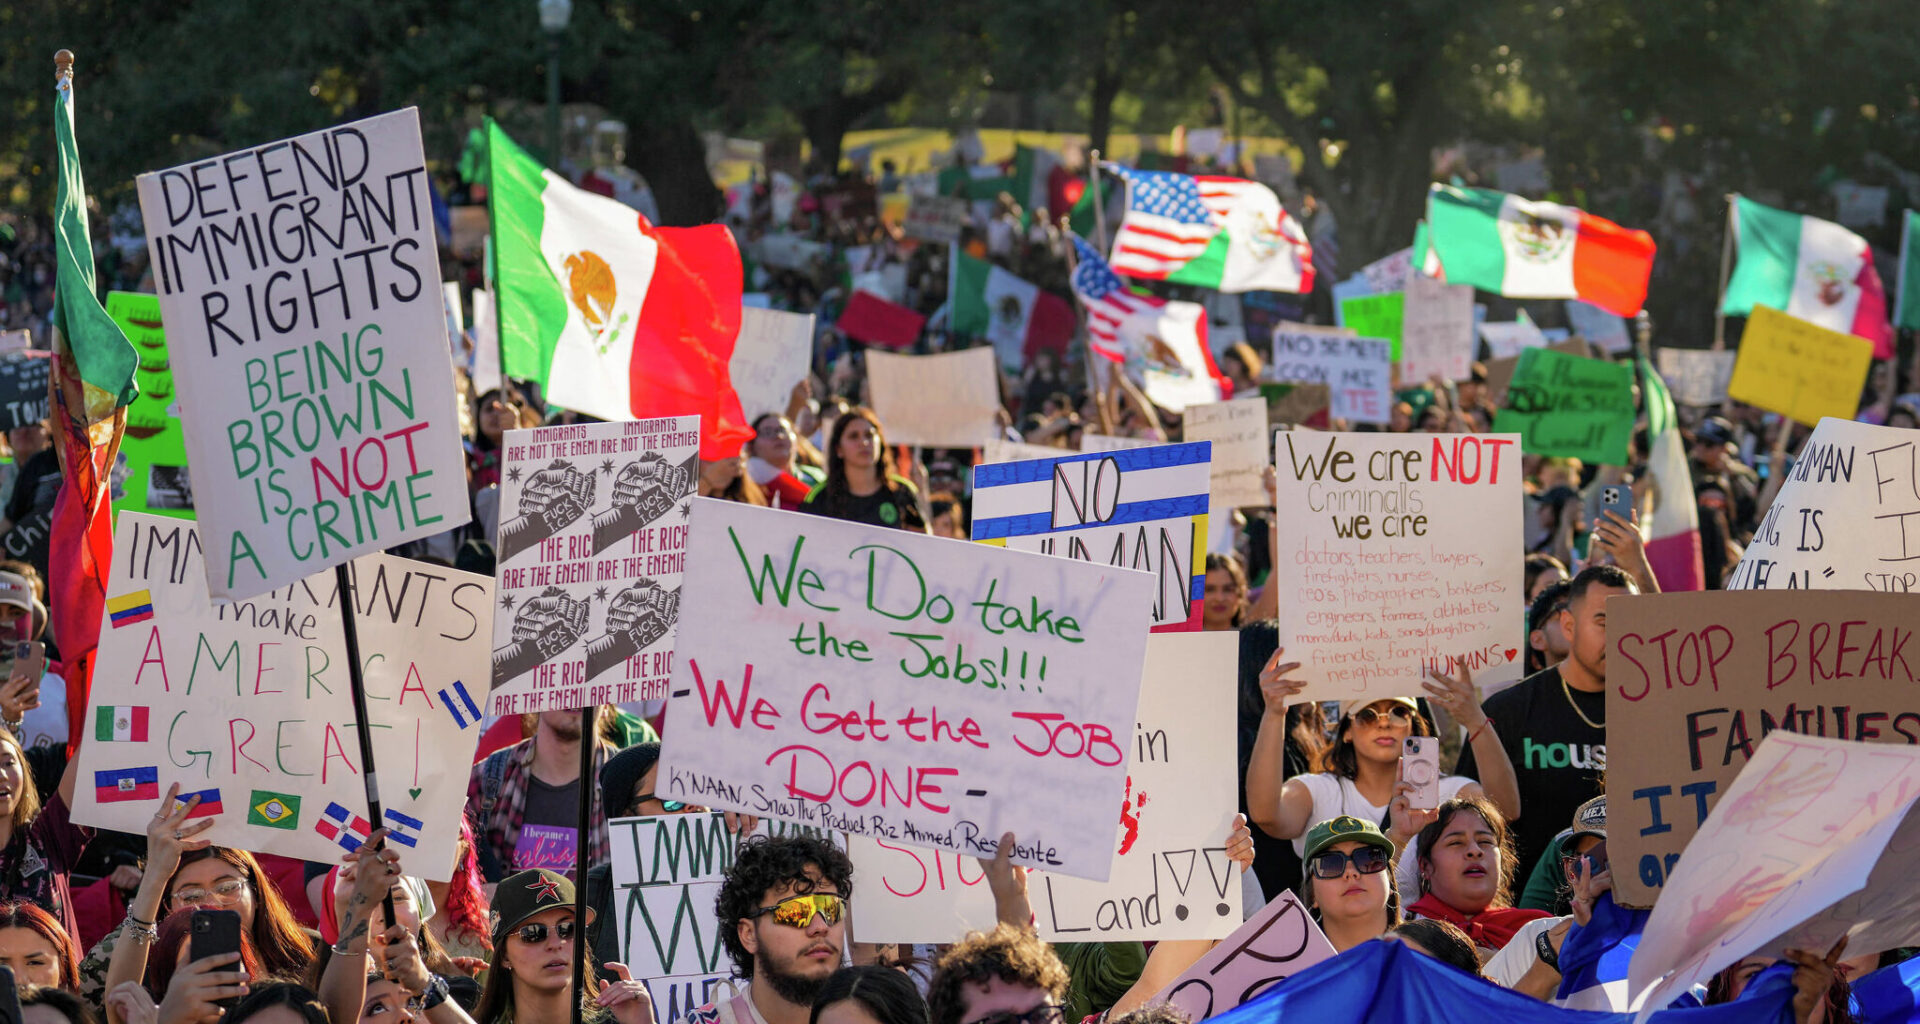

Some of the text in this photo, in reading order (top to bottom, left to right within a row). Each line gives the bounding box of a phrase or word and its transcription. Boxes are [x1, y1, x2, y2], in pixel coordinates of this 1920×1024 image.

[160, 127, 370, 227] DEFEND
[155, 166, 425, 295] IMMIGRANT
[201, 237, 422, 357] RIGHTS
[245, 323, 383, 413] BEING
[227, 367, 415, 479] BROWN
[532, 425, 587, 443] IMMIGRANTS
[623, 418, 677, 436] IMMIGRANTS
[508, 446, 525, 462] ARE
[529, 444, 547, 460] NOT
[551, 441, 567, 458] THE
[600, 431, 698, 455] ARE NOT THE ENEMIES
[1286, 432, 1514, 485] We are NOT
[254, 421, 429, 524] IS NOT
[542, 498, 573, 524] FUCK
[634, 490, 664, 516] FUCK
[1051, 455, 1122, 530] NO
[227, 469, 444, 589] A CRIME
[630, 528, 655, 554] THE
[1332, 514, 1428, 540] we are
[1796, 508, 1825, 553] IS
[539, 536, 564, 563] THE
[502, 567, 526, 590] ARE
[530, 565, 552, 587] THE
[596, 559, 619, 582] ARE
[622, 557, 643, 579] THE
[727, 526, 841, 613] We
[848, 543, 956, 625] Do
[972, 578, 1086, 644] take
[218, 602, 318, 641] make
[535, 625, 567, 651] FUCK
[628, 616, 658, 641] FUCK
[135, 624, 434, 710] AMERCA
[624, 653, 649, 680] THE
[788, 621, 1048, 693] the Jobs!!!
[1421, 643, 1504, 679] HUMANS
[1617, 619, 1920, 702] STOP BREAK
[532, 663, 557, 690] THE
[589, 685, 612, 707] ARE
[616, 682, 637, 704] THE
[494, 694, 518, 716] ARE
[522, 691, 544, 714] THE
[799, 682, 890, 742] Get
[896, 704, 990, 750] the
[1011, 711, 1124, 768] JOB
[1136, 722, 1169, 763] in
[669, 765, 749, 808] K'NAAN,
[870, 814, 900, 840] Riz
[903, 819, 960, 850] Ahmed,
